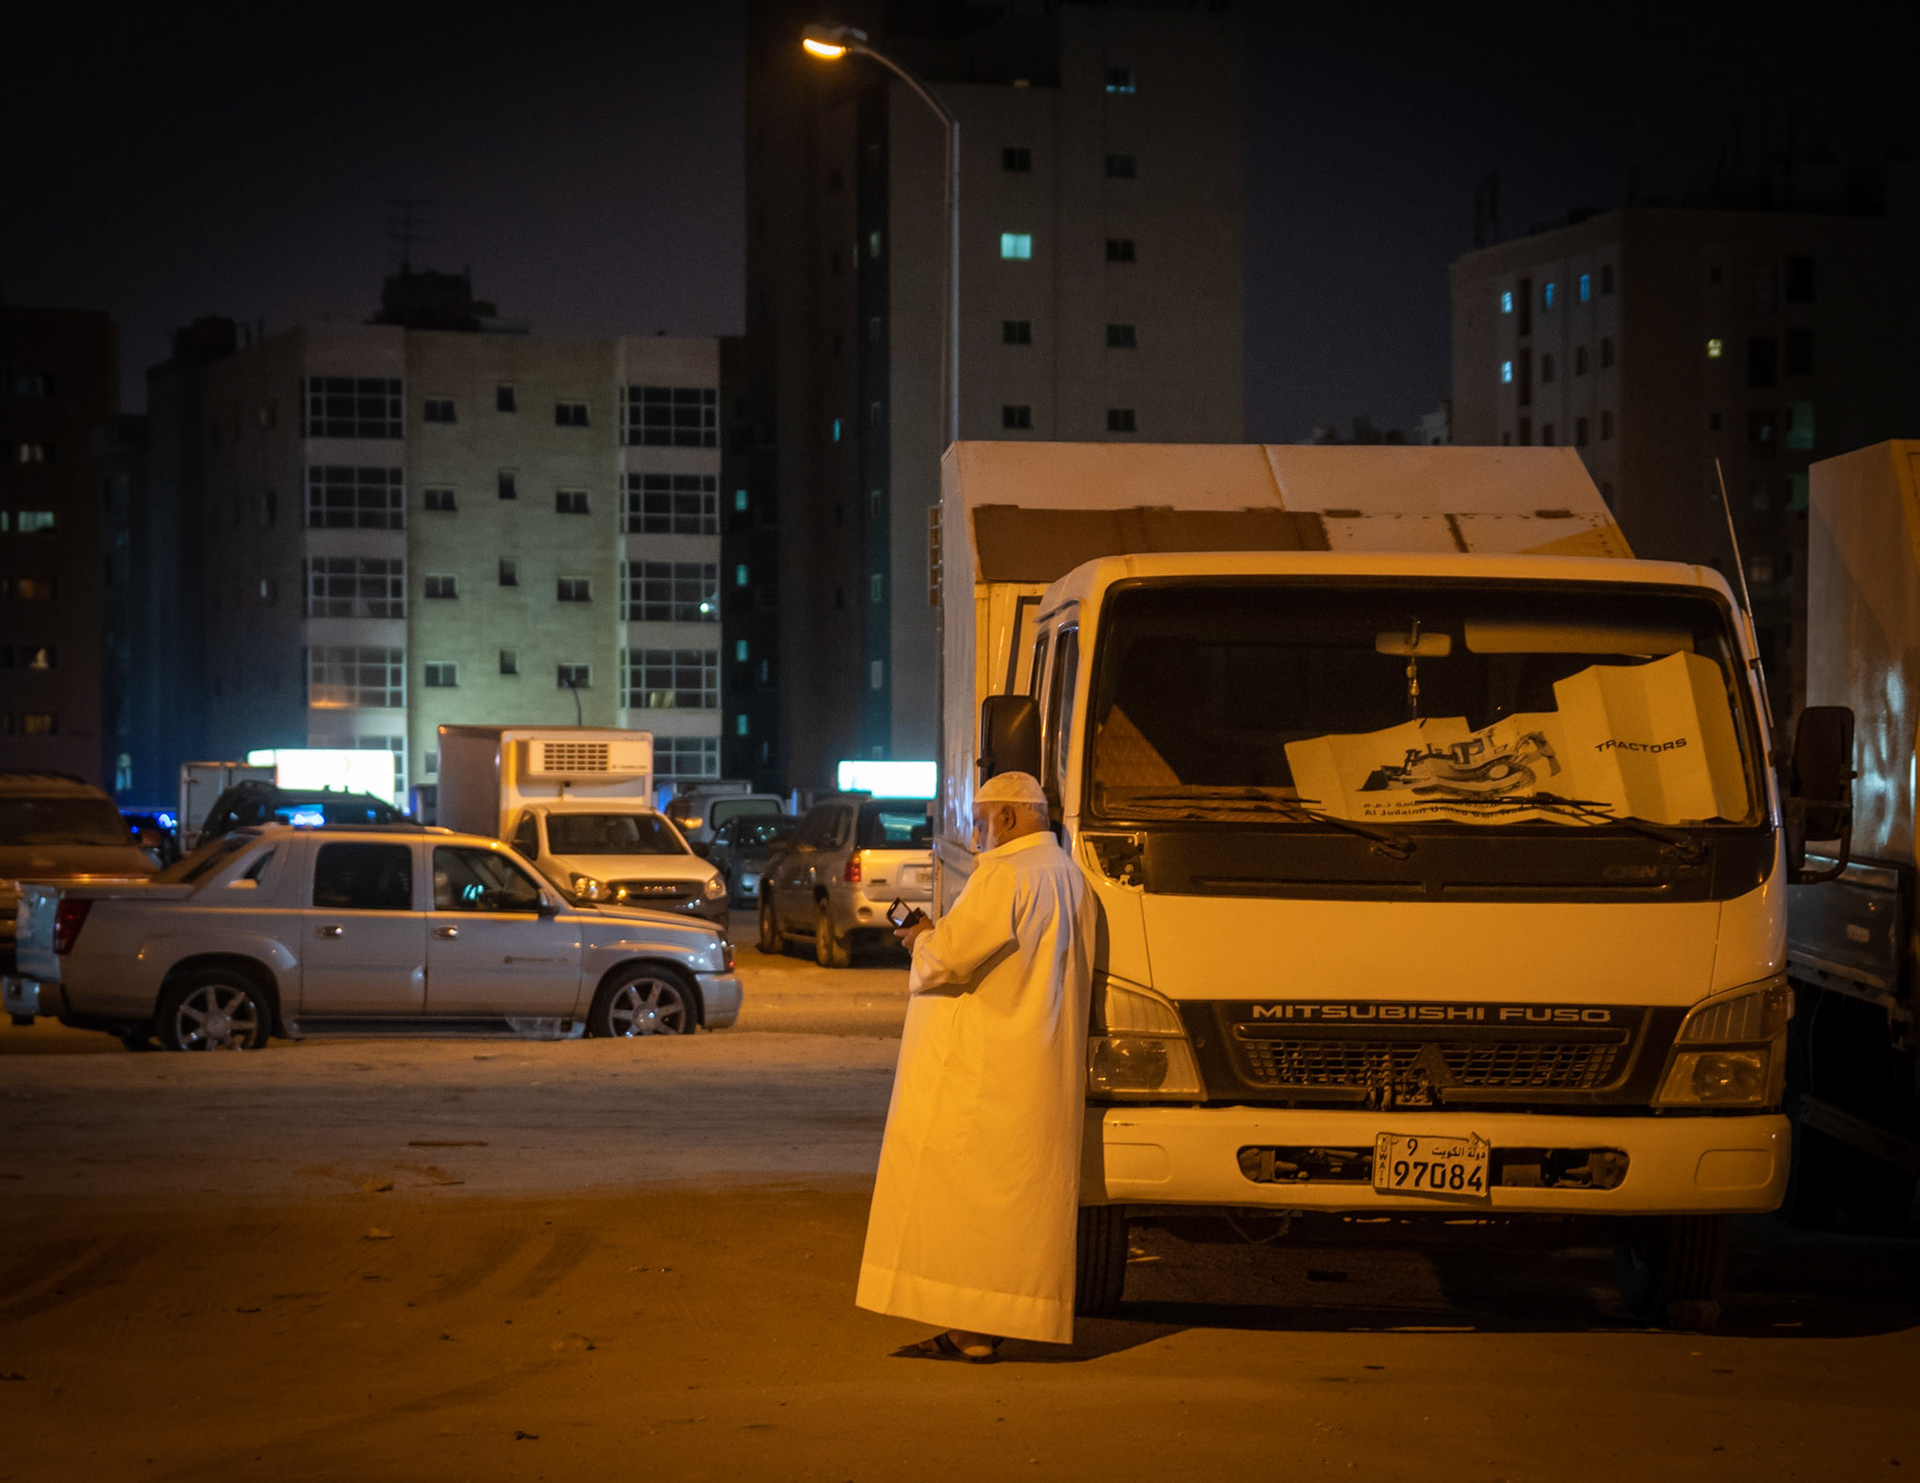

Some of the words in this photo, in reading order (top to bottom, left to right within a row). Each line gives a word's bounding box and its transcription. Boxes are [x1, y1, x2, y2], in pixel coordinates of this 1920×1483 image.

[1595, 738, 1687, 753] TRACTORS
[1252, 1005, 1485, 1021] MITSUBISHI
[1500, 1007, 1611, 1023] FUSO
[1407, 1138, 1418, 1157] 9
[1431, 1146, 1465, 1159] الكويت
[1467, 1146, 1486, 1161] دولة
[1379, 1137, 1388, 1185] KUWAIT
[1394, 1160, 1483, 1192] 97084
